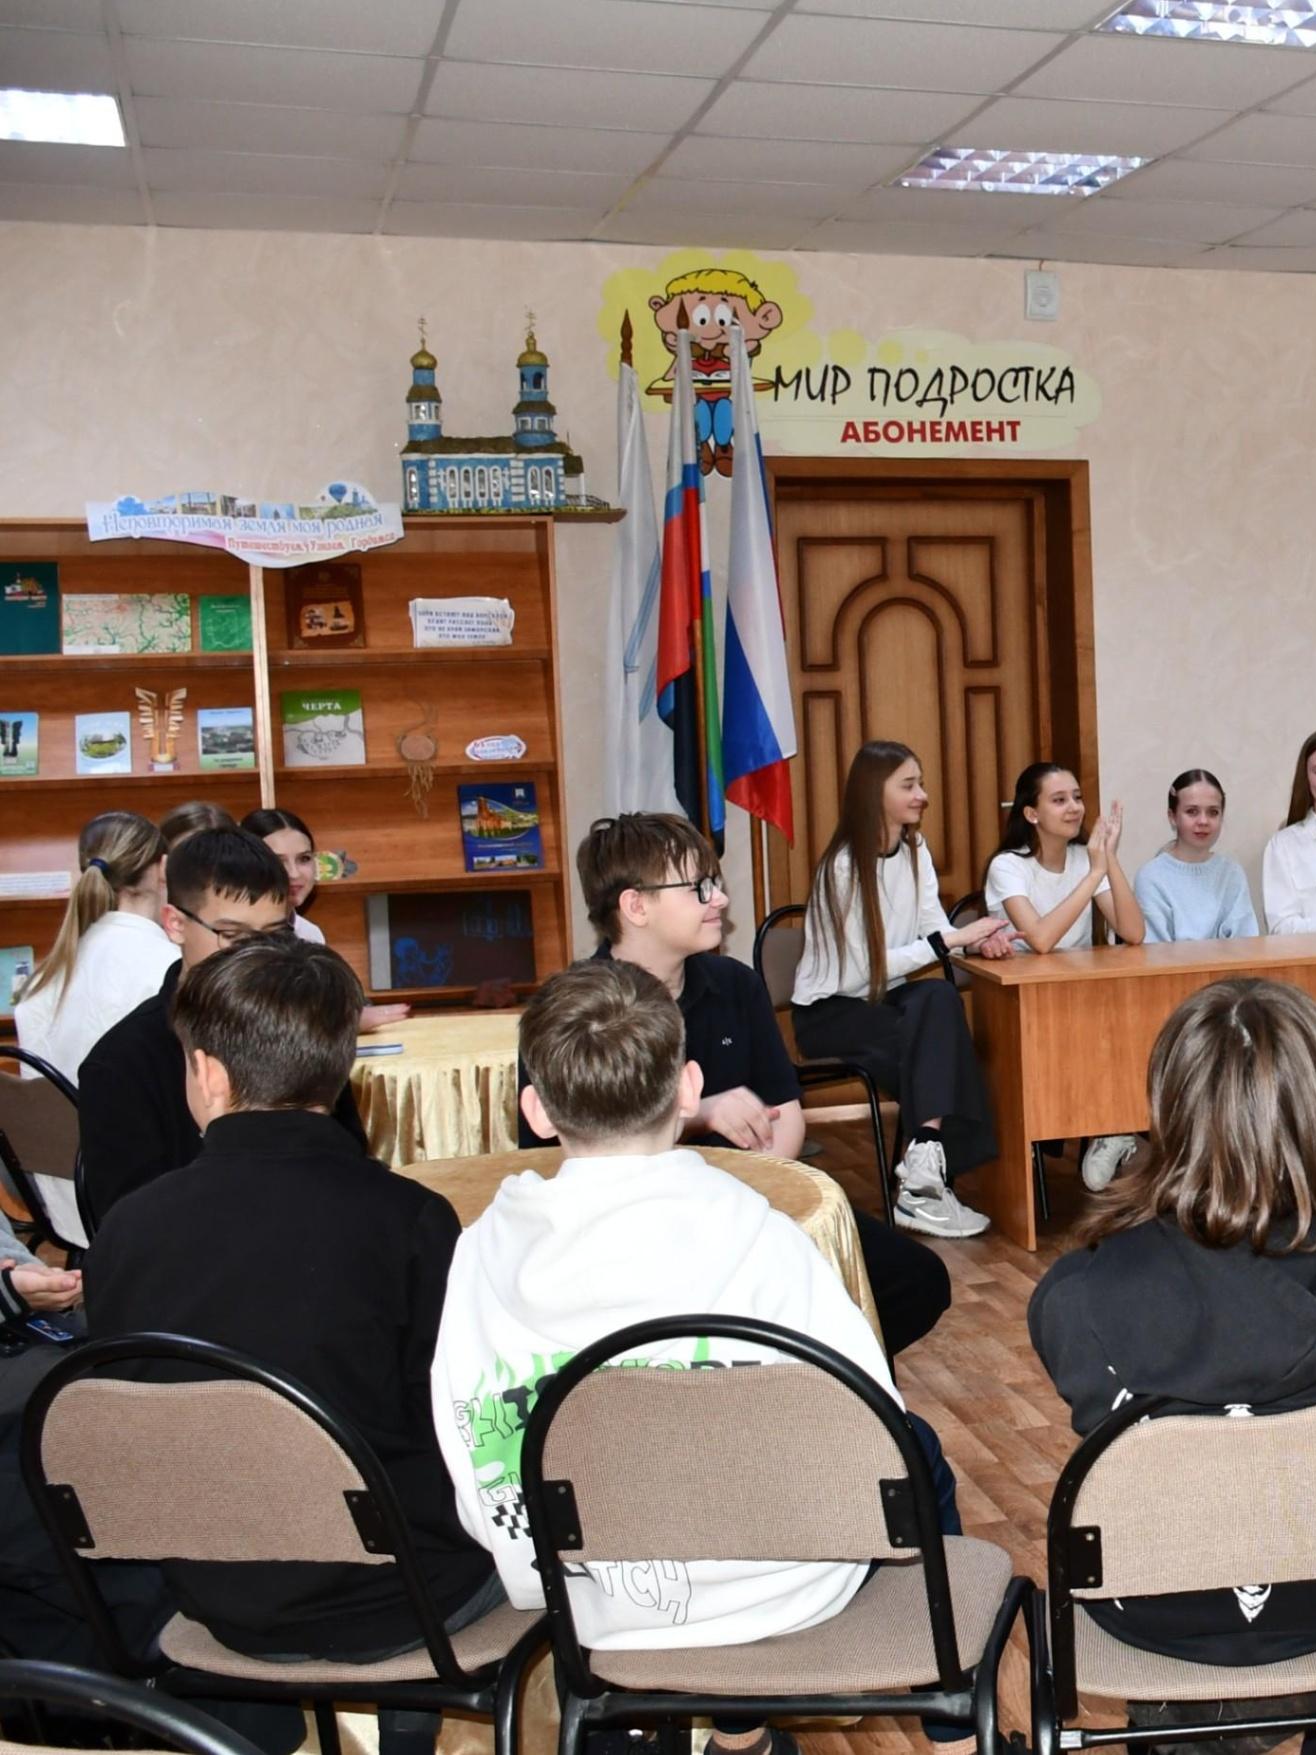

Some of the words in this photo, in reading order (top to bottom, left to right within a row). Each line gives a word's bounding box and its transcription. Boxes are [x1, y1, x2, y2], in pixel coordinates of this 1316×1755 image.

[774, 364, 851, 405] МИР
[867, 365, 1075, 418] ПОДРОСТКА
[840, 421, 1021, 444] АБОНЕМЕНТ
[292, 520, 321, 534] моя
[327, 513, 383, 537] родная
[302, 702, 342, 711] ЧЕРТА
